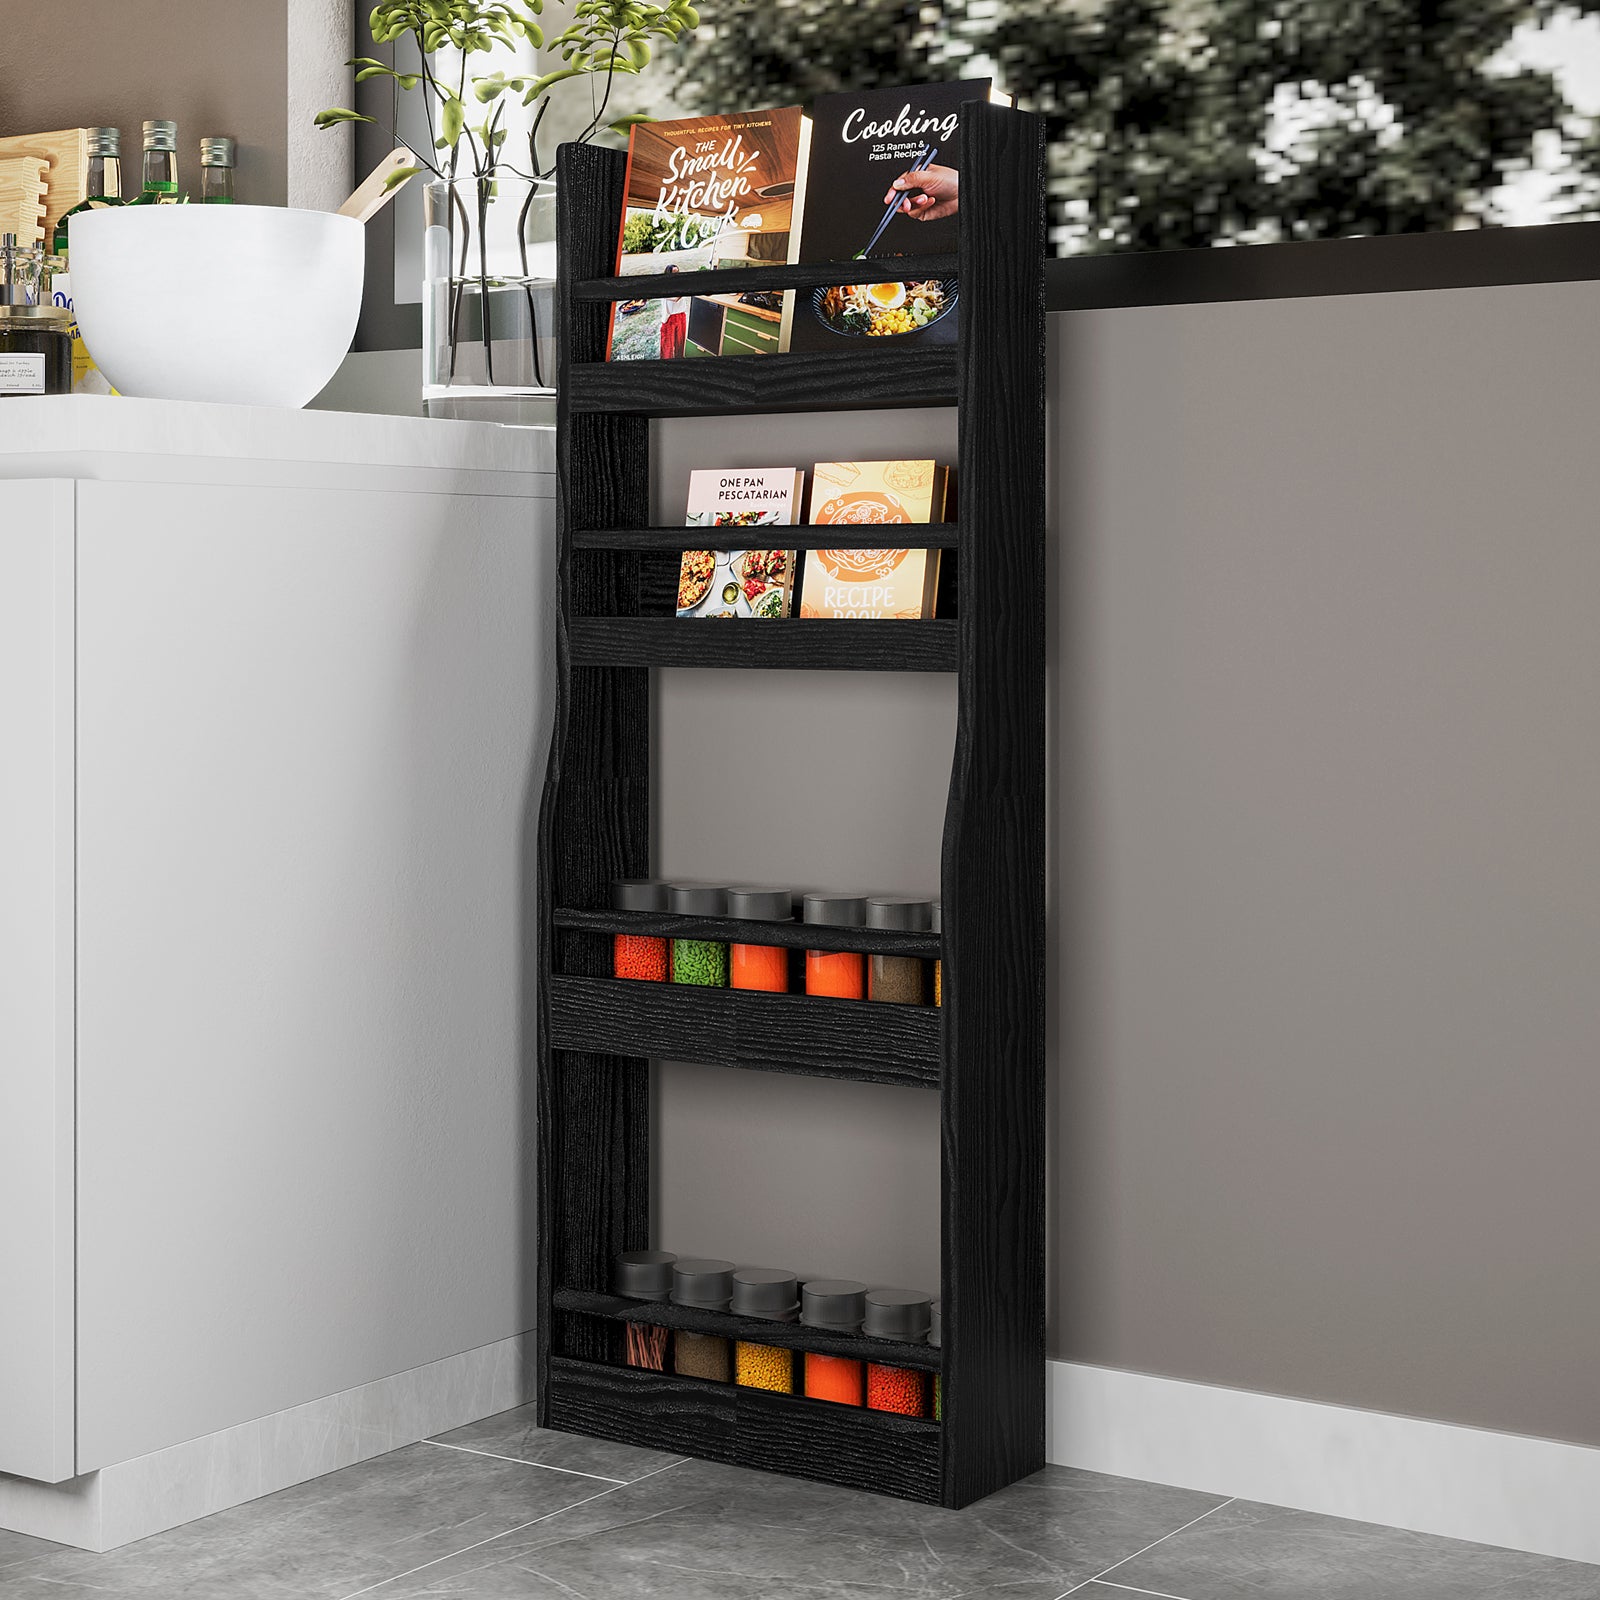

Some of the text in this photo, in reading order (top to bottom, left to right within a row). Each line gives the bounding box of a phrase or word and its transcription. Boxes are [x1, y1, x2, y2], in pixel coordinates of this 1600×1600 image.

[663, 129, 696, 137] THOUGHTFUL
[747, 120, 772, 128] KITCHENS
[842, 103, 959, 143] Cooking
[695, 140, 717, 153] THE
[872, 140, 925, 152] 125 Raman &
[662, 134, 742, 184] Small
[868, 149, 927, 161] Pasta Recipes
[652, 170, 751, 228] Kitchen
[680, 199, 739, 249] Cook
[720, 477, 764, 488] ONE PAN
[718, 489, 788, 500] PESCATARIAN
[824, 586, 896, 608] RECIPE
